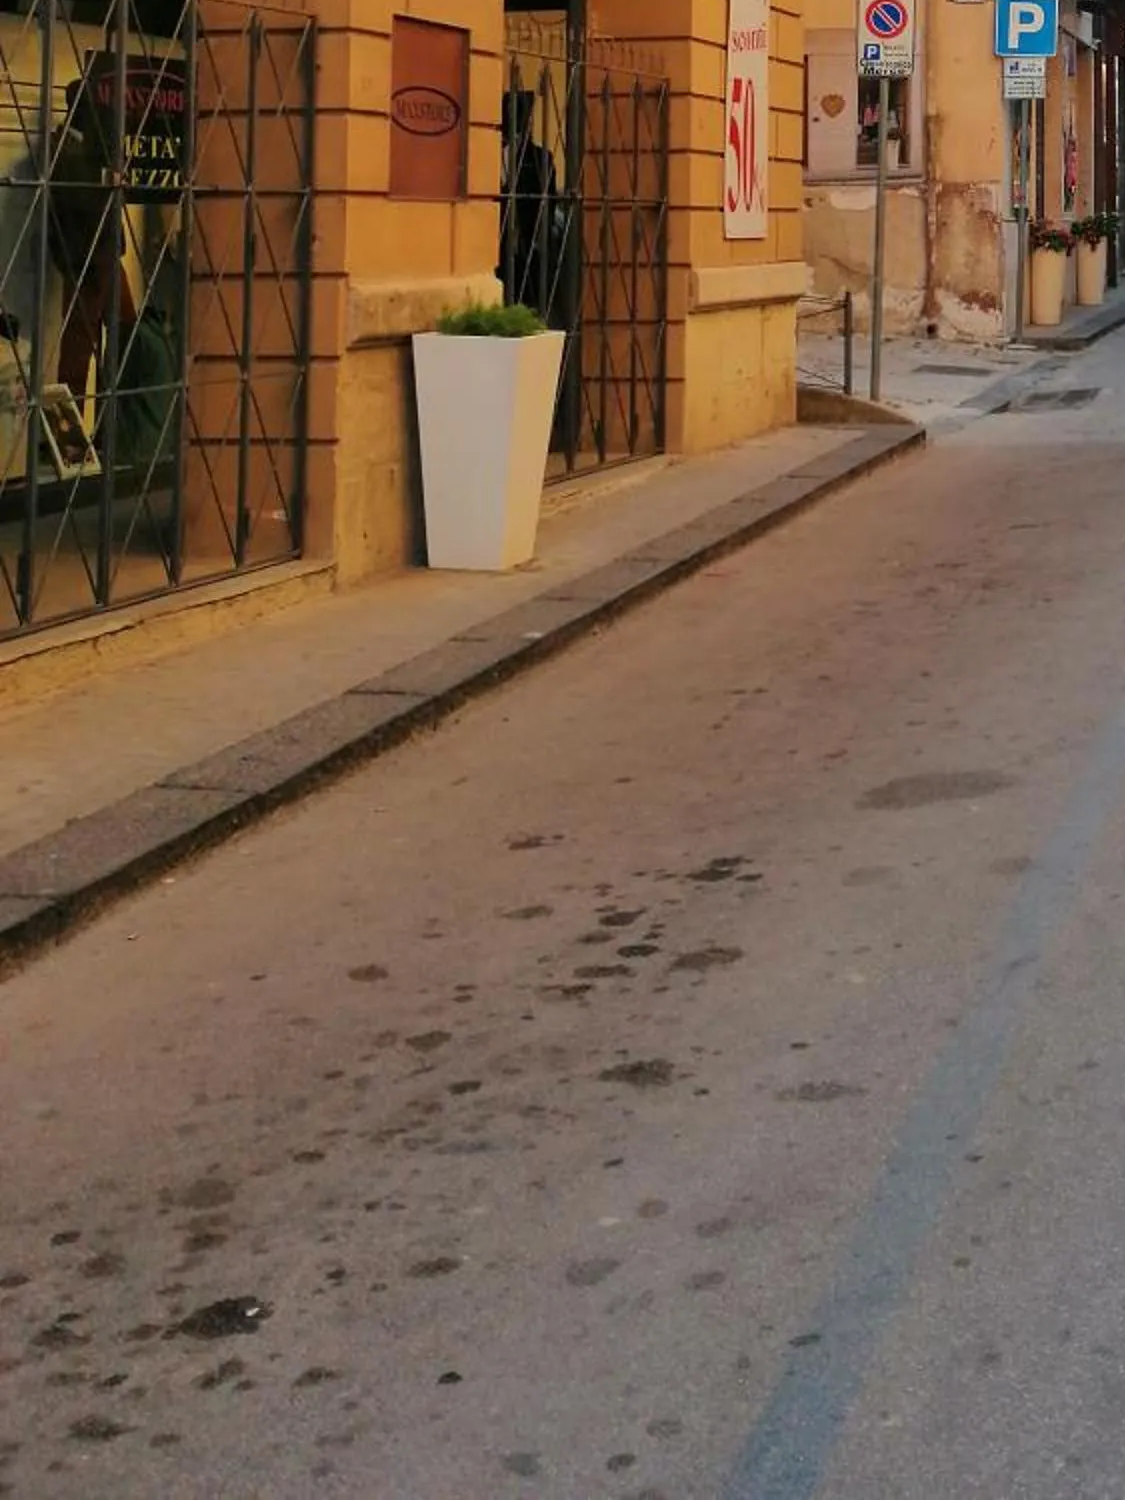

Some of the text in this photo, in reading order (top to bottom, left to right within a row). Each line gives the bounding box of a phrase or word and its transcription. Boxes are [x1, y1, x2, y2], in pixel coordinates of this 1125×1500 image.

[1007, 2, 1045, 49] P
[867, 45, 878, 59] P
[101, 167, 182, 188] EZZO
